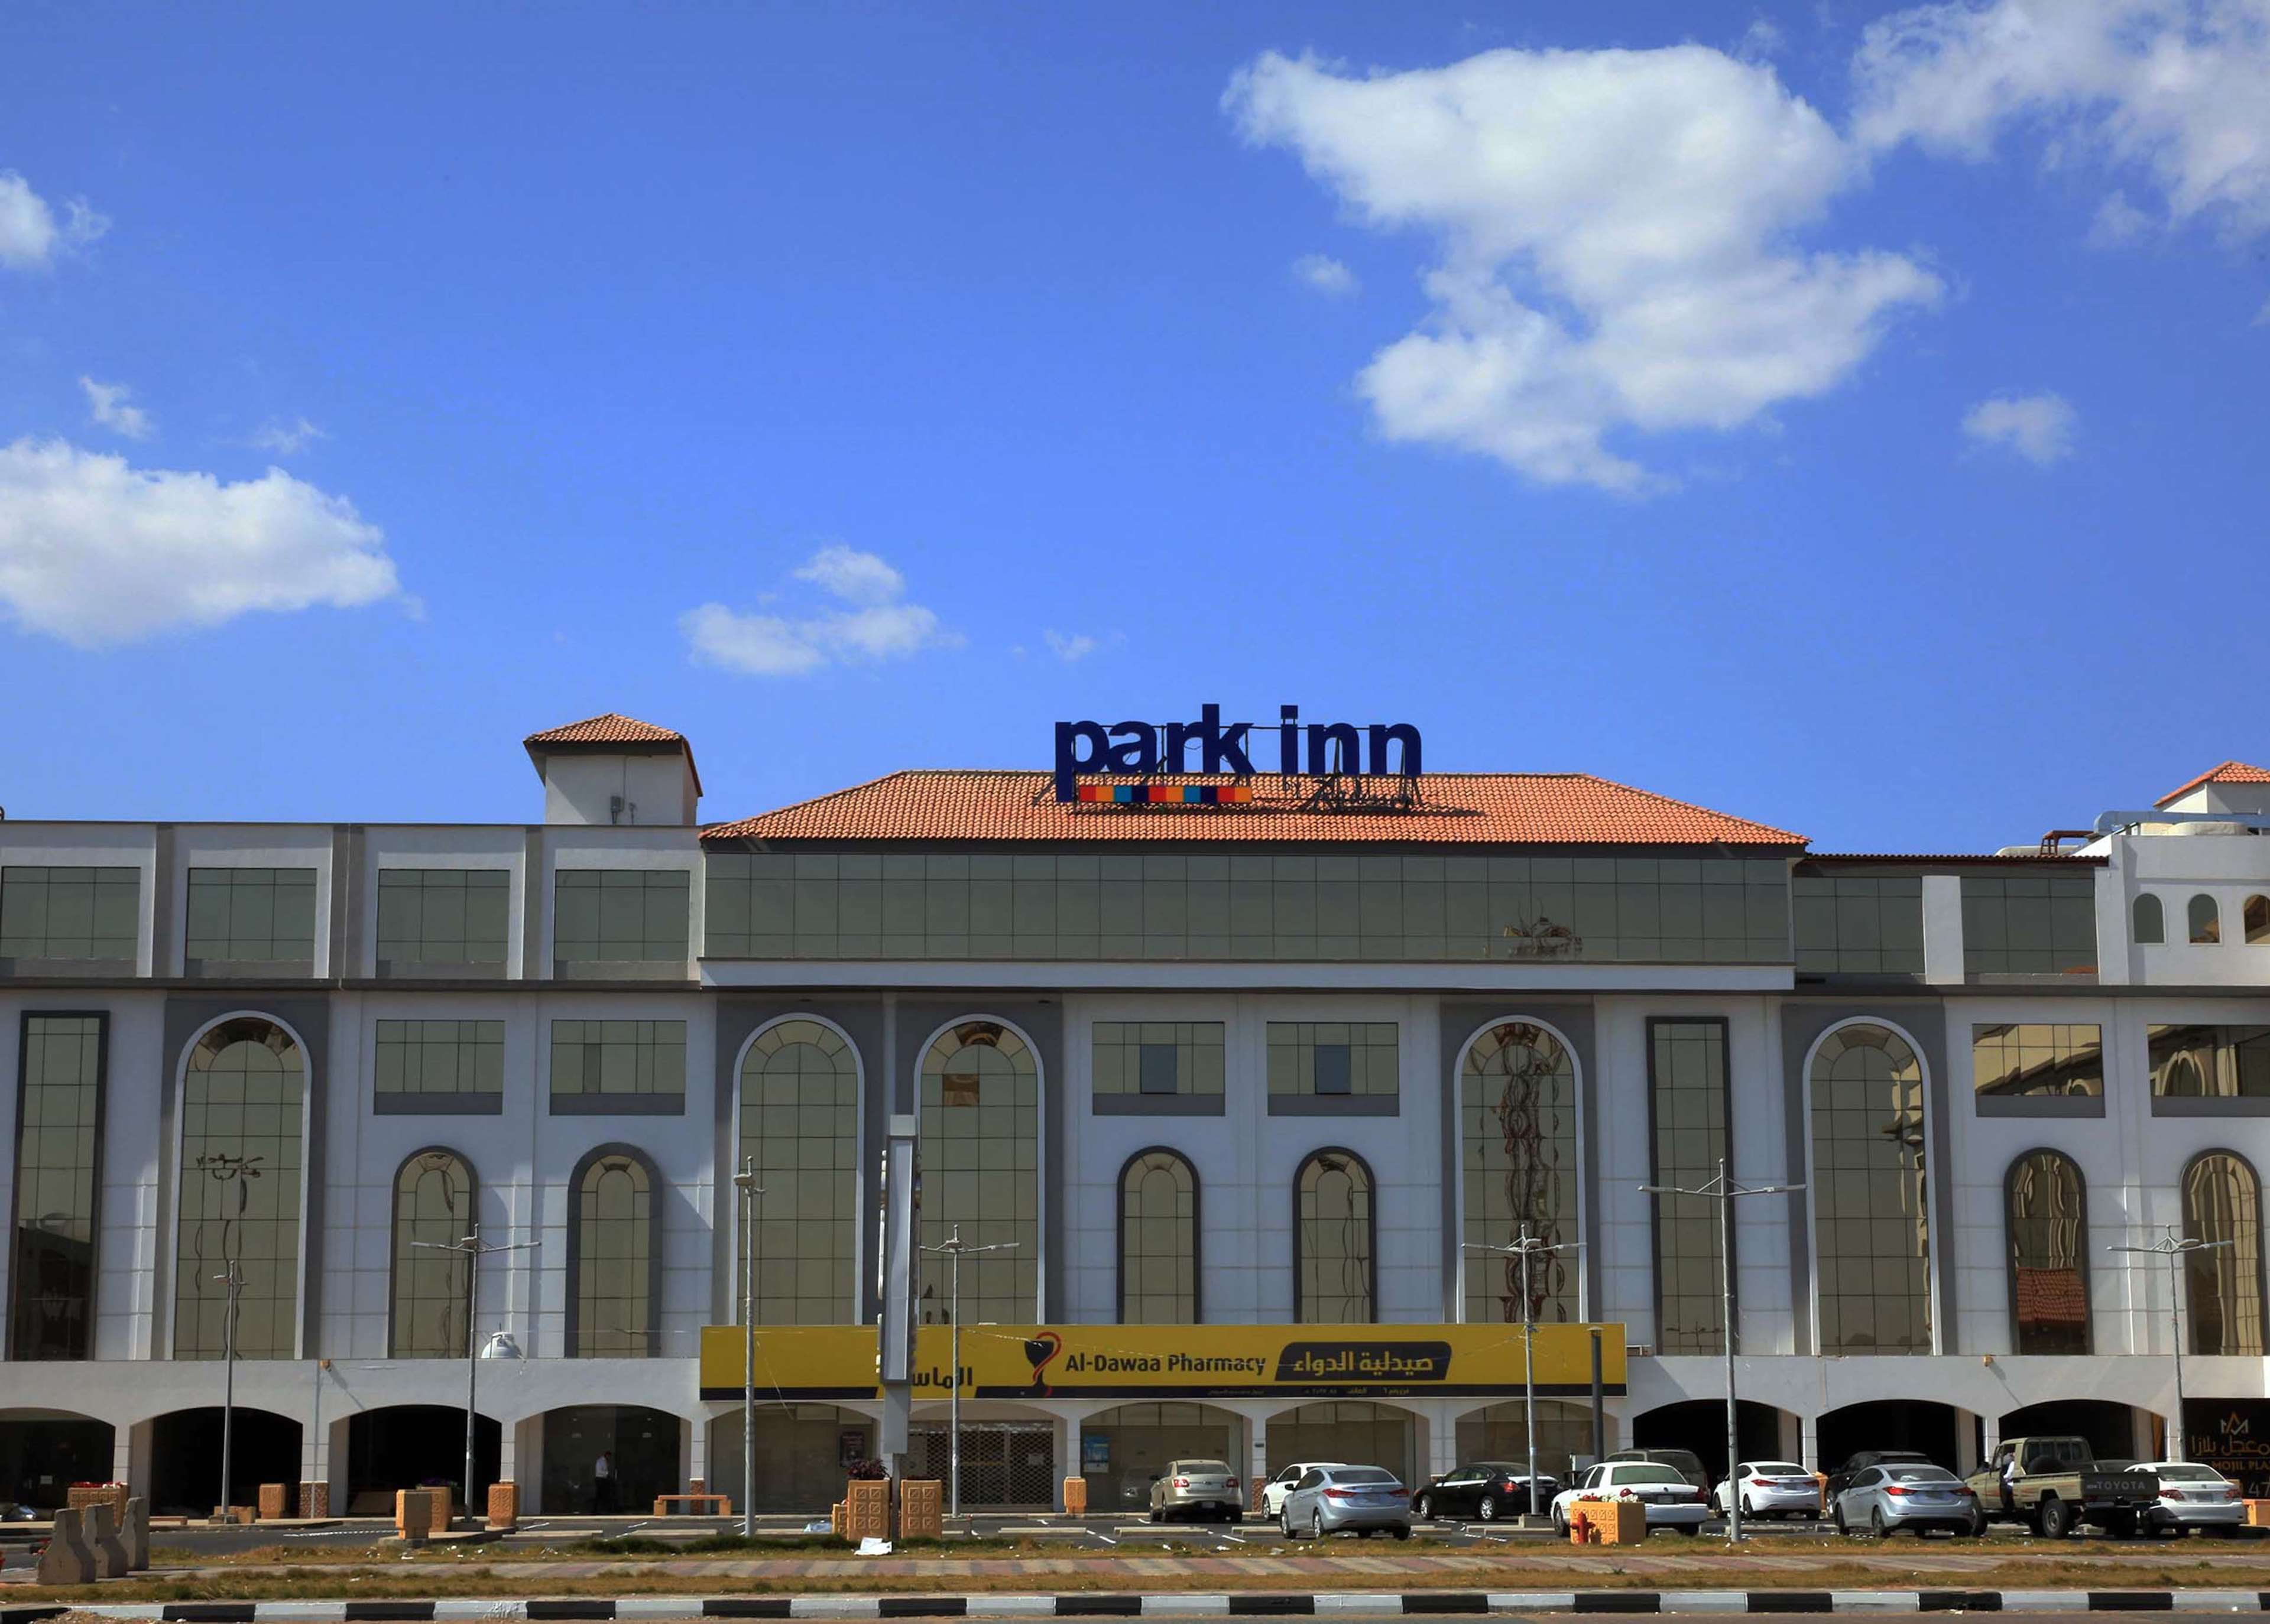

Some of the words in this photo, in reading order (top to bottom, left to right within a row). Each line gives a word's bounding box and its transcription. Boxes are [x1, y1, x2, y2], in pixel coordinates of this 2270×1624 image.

[1055, 704, 1257, 803] park
[1280, 705, 1422, 775] inn
[1065, 1353, 1161, 1372] Al-Dawaa
[1168, 1353, 1266, 1376] Pharmacy
[1293, 1350, 1354, 1376] الدواء
[1360, 1351, 1434, 1376] صيدلية
[912, 1366, 972, 1389] الماس
[2248, 1460, 2270, 1470] PLA
[2097, 1480, 2146, 1490] TOYOTA
